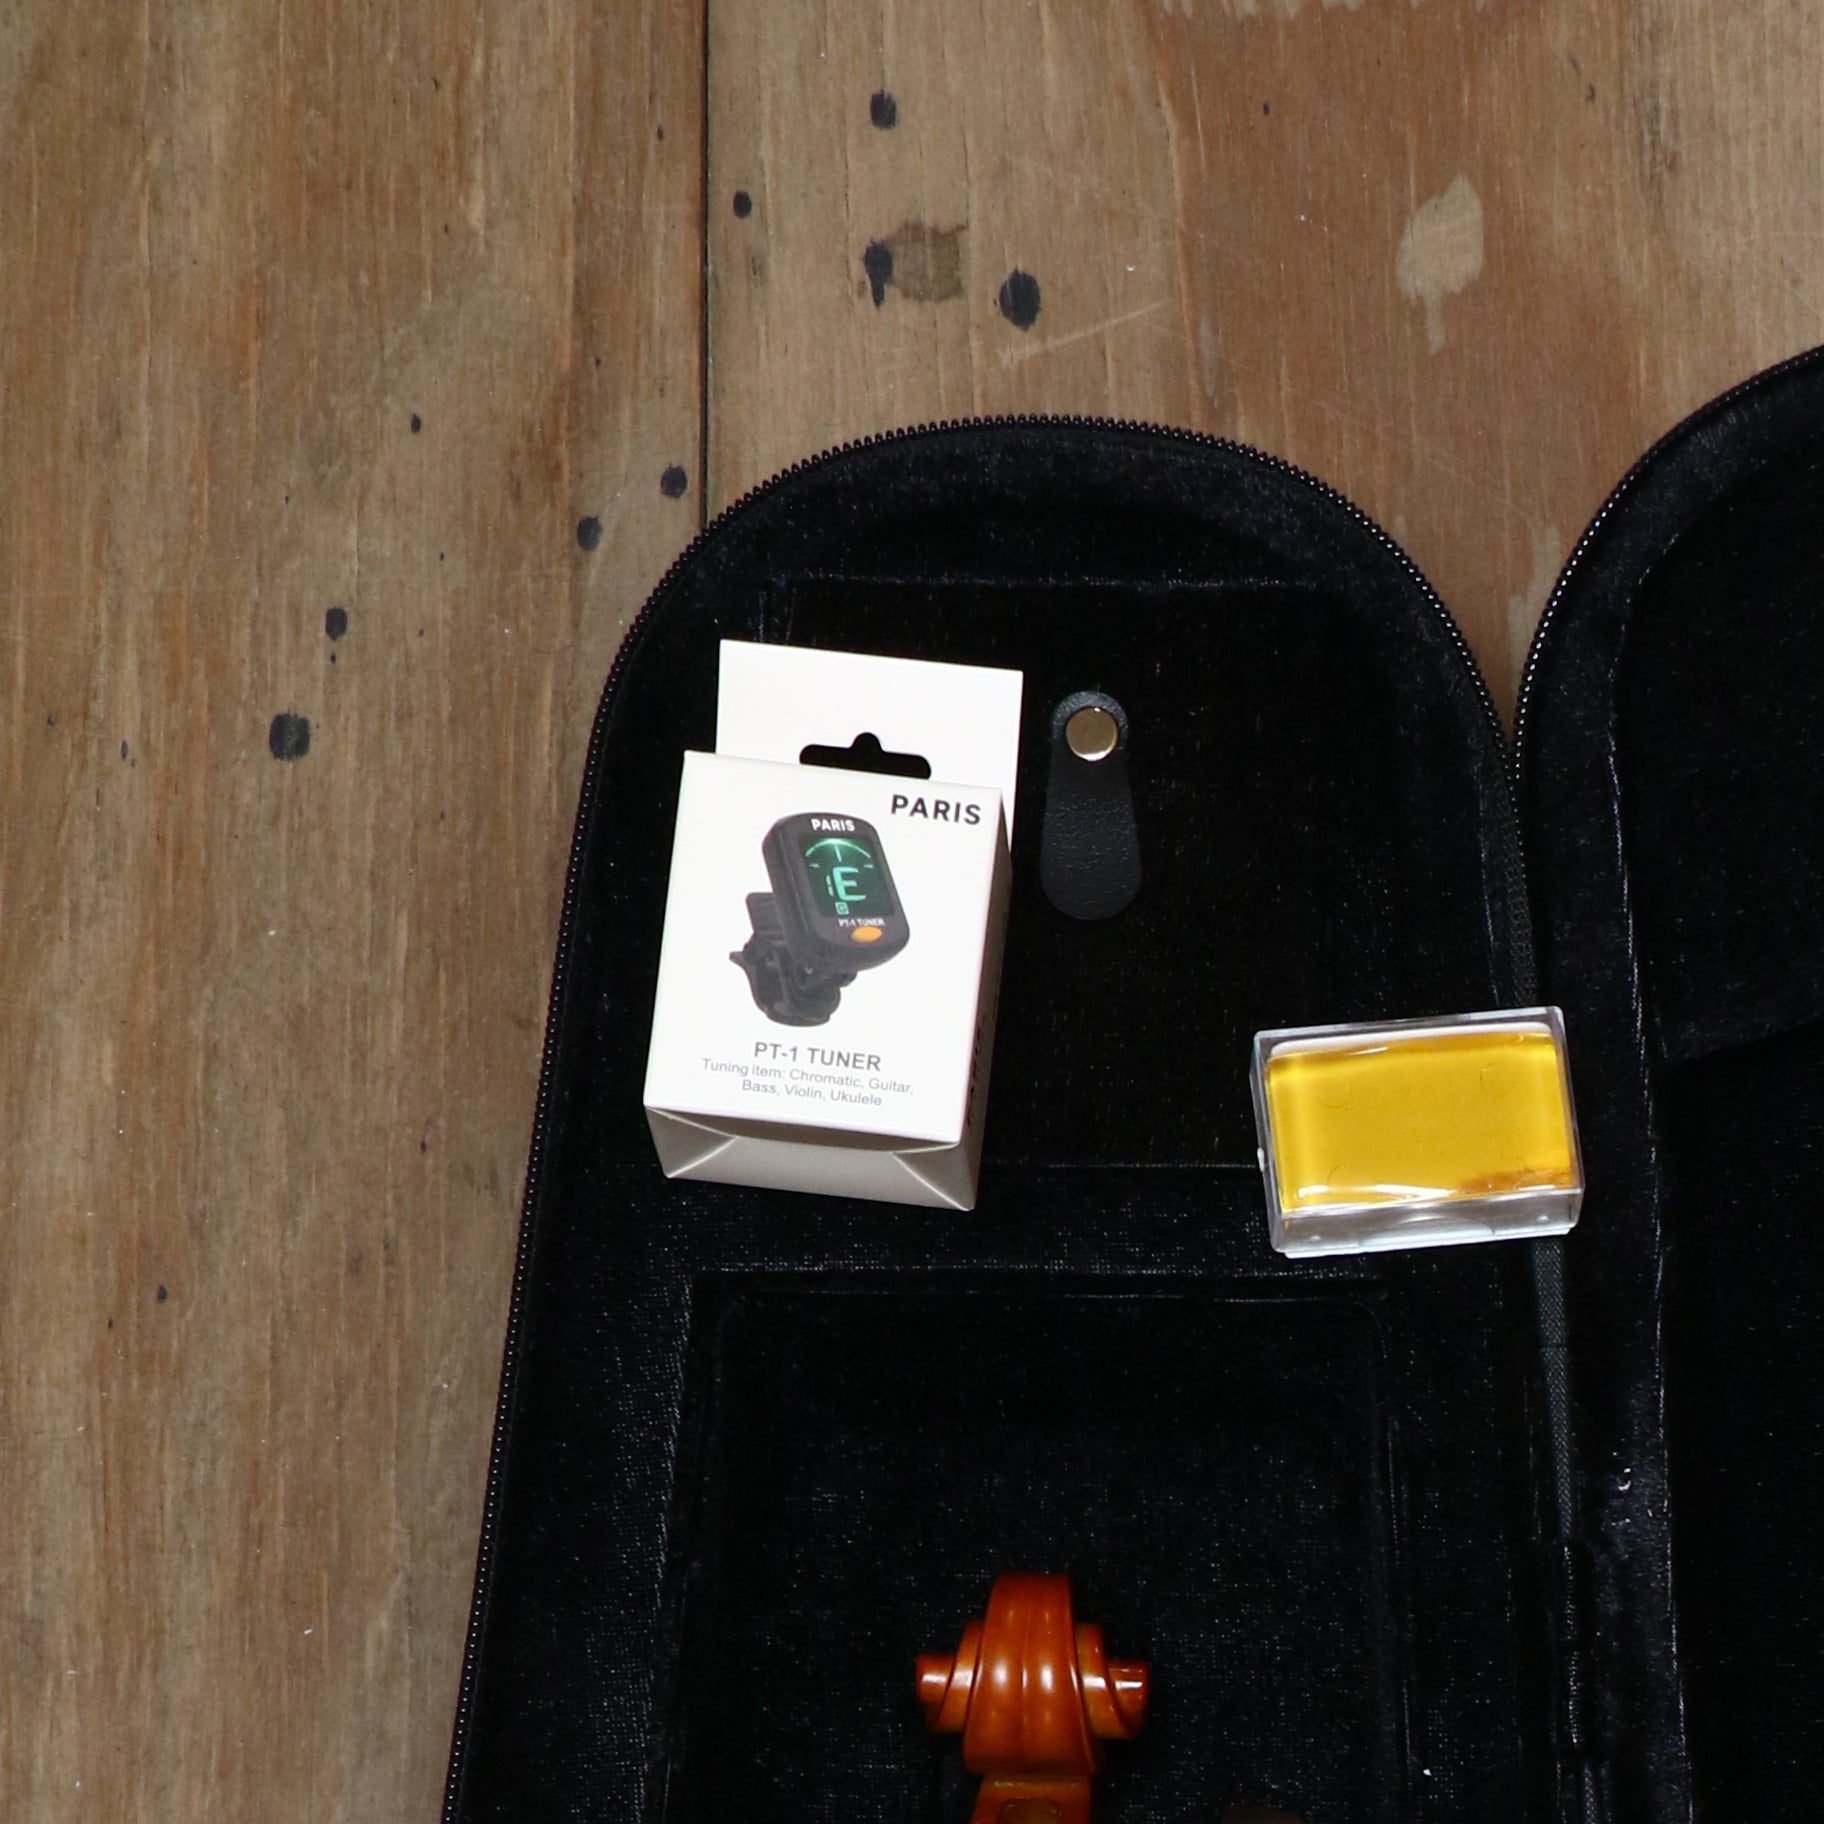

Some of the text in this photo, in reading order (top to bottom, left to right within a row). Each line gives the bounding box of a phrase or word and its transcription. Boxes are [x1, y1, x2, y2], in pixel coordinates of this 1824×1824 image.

[891, 794, 982, 825] PARIS
[811, 818, 855, 832] PARIS
[858, 918, 886, 927] TUNER
[754, 1041, 882, 1072] PT-1 TUNER
[702, 1058, 914, 1096] Tuning item: Chromatic, Guitar,
[742, 1079, 882, 1106] Bass, Violin, Ukulele
